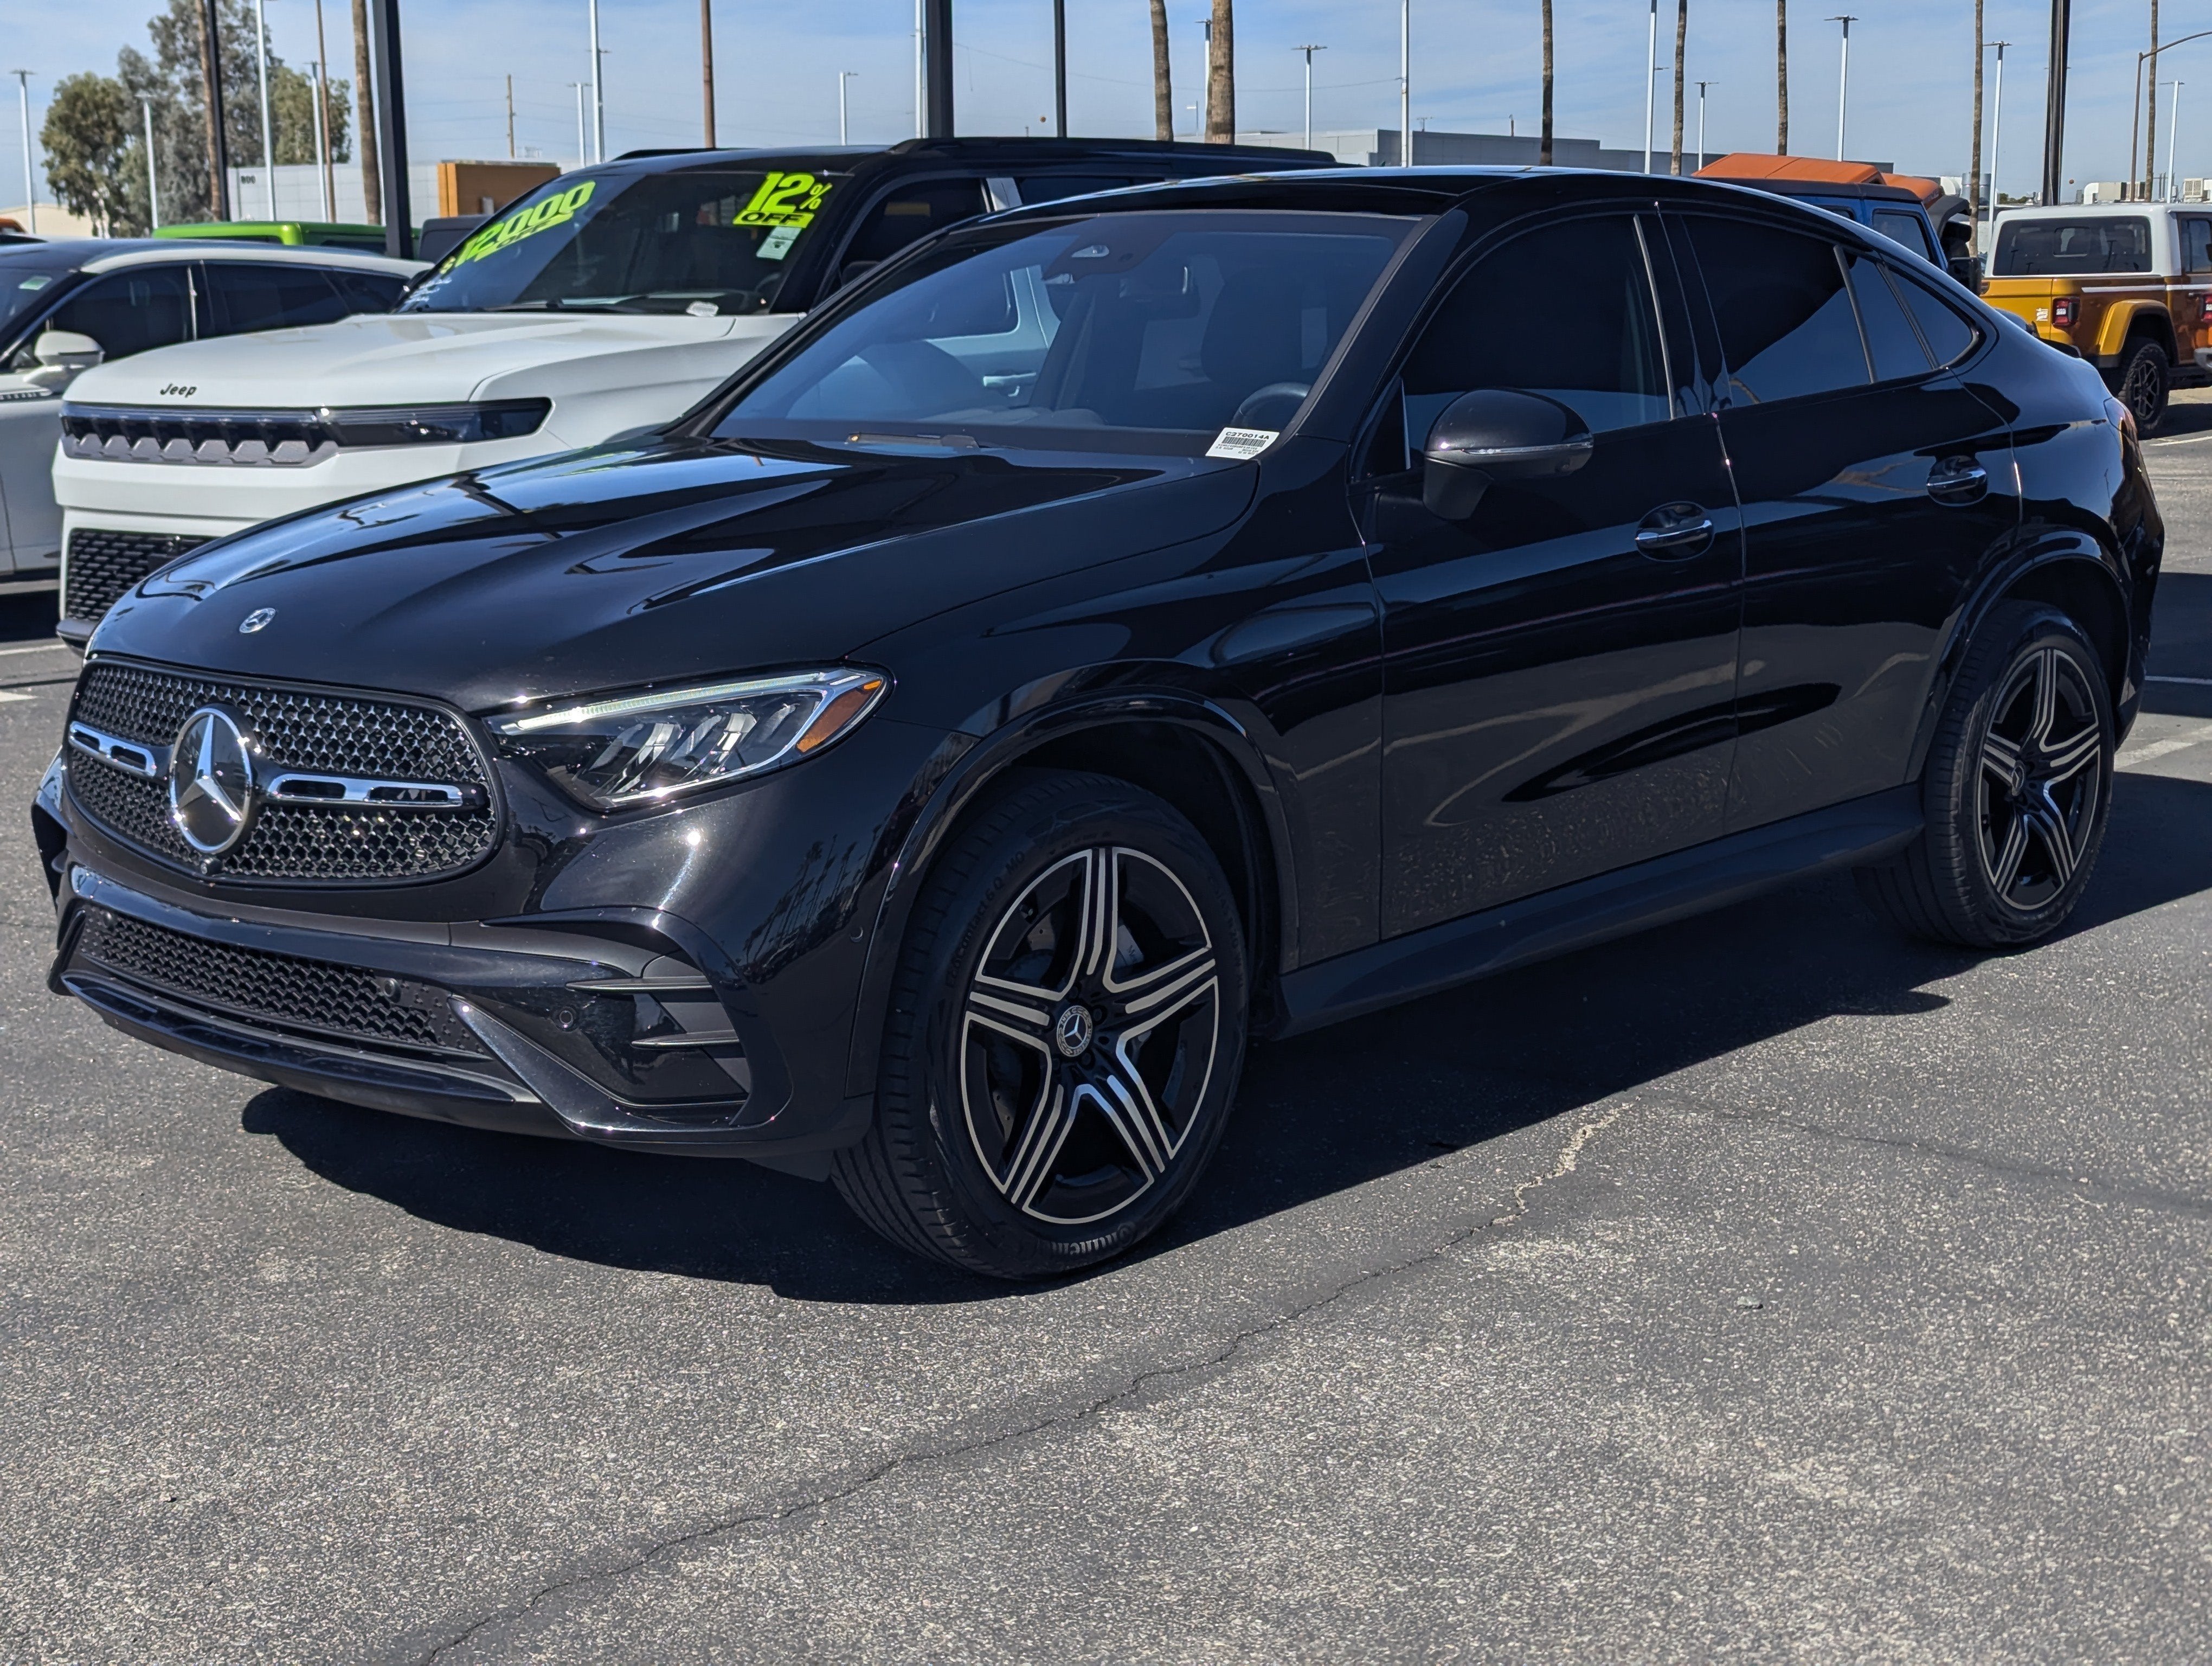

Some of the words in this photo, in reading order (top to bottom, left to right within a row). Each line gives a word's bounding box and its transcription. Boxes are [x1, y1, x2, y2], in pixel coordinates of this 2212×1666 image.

[747, 171, 833, 213] 12%
[741, 212, 803, 227] OFF
[160, 383, 197, 398] Jeep
